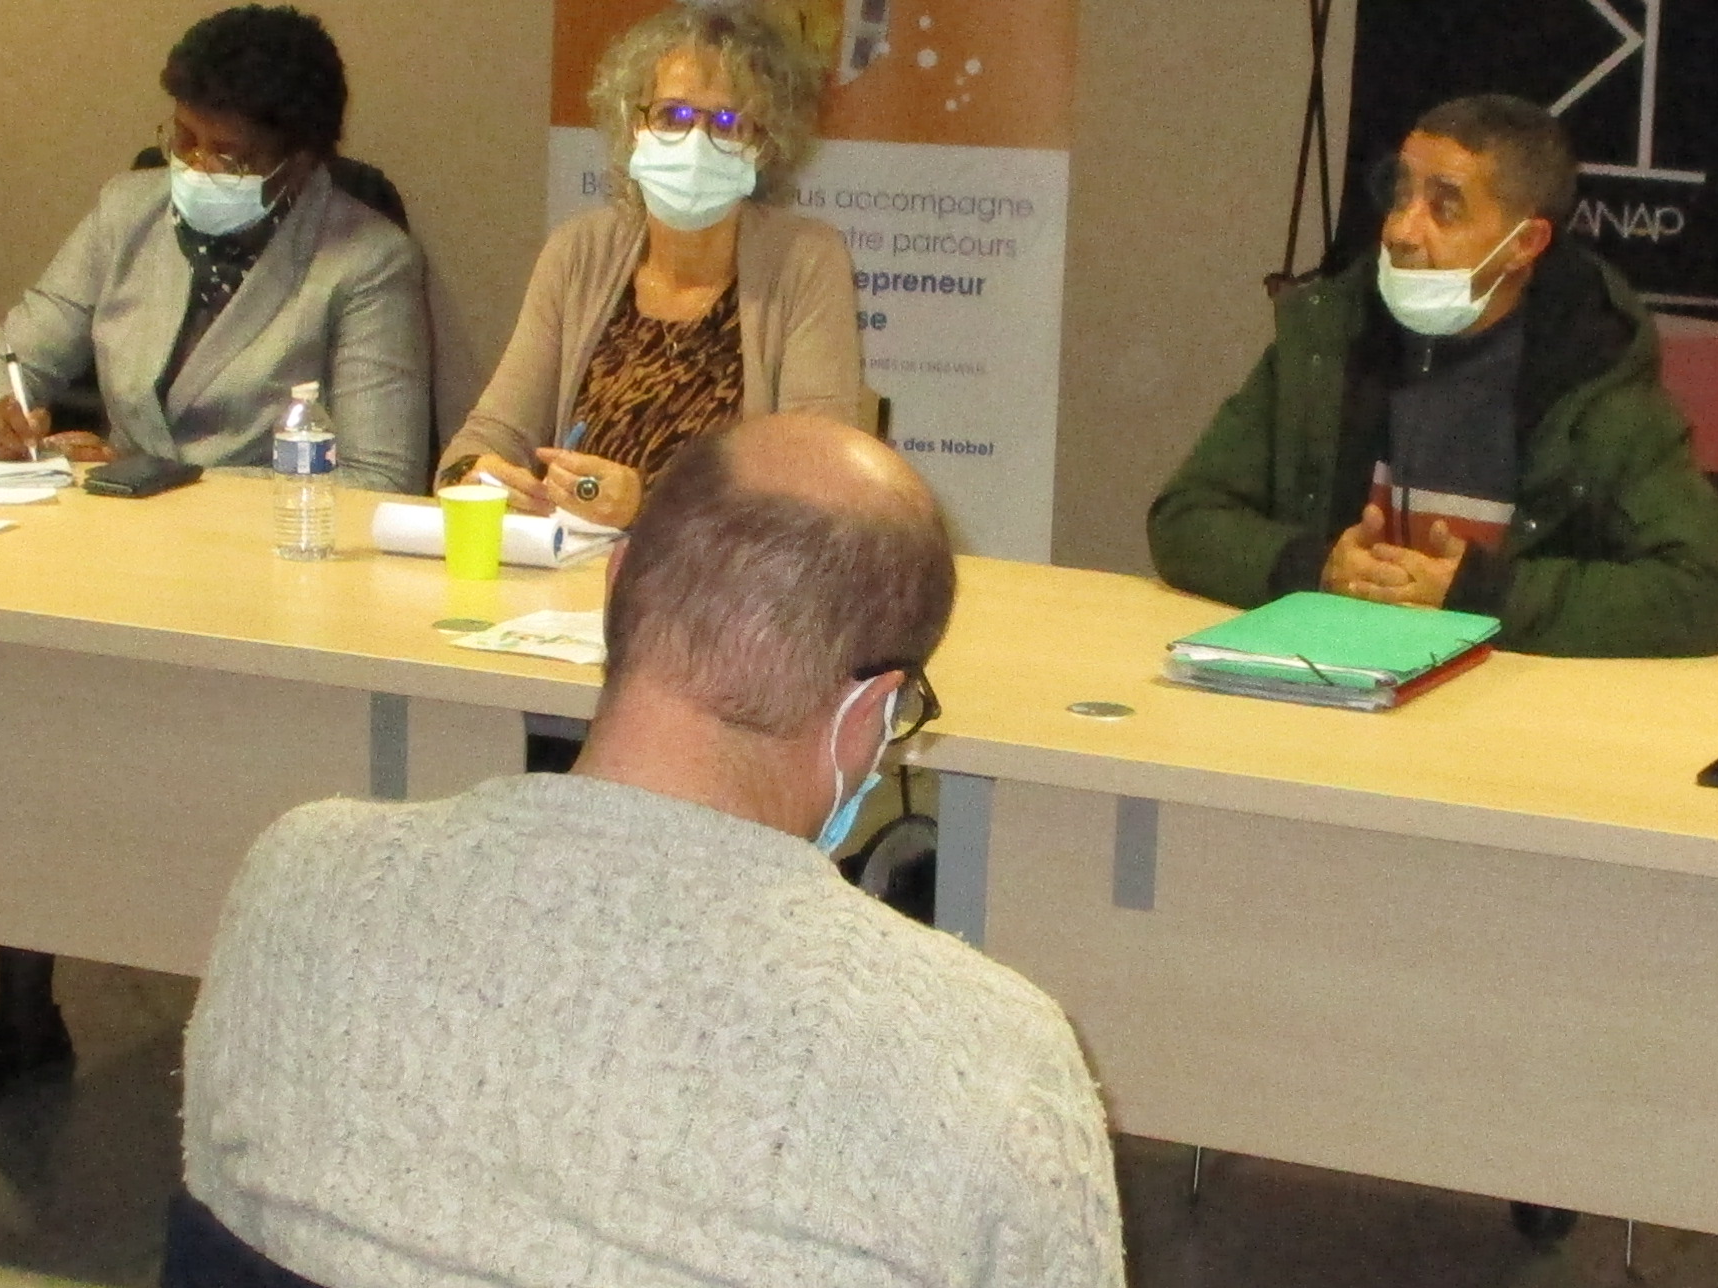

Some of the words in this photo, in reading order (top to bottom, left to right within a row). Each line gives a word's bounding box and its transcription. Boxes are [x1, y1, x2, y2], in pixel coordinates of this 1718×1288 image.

[834, 188, 1035, 223] accompagne
[1566, 198, 1686, 244] ANAP
[892, 231, 1018, 258] parcours
[854, 268, 987, 296] epreneur
[903, 437, 936, 454] des
[940, 438, 995, 457] Nobel
